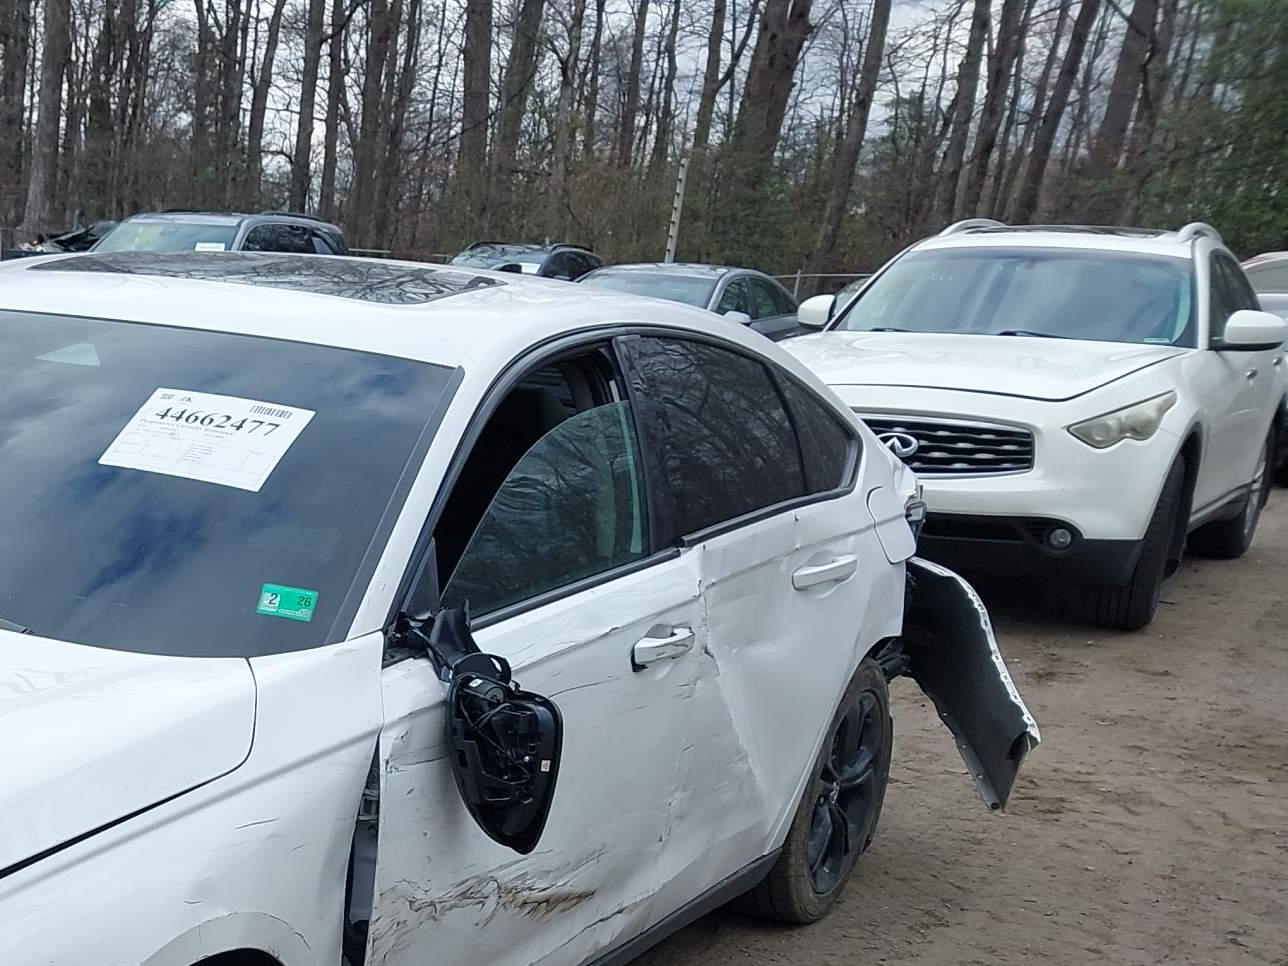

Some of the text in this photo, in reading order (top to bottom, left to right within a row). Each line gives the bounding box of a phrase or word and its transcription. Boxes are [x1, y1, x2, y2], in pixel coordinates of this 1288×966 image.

[155, 407, 281, 437] 44662477
[269, 592, 278, 605] 2
[297, 595, 312, 607] 26
